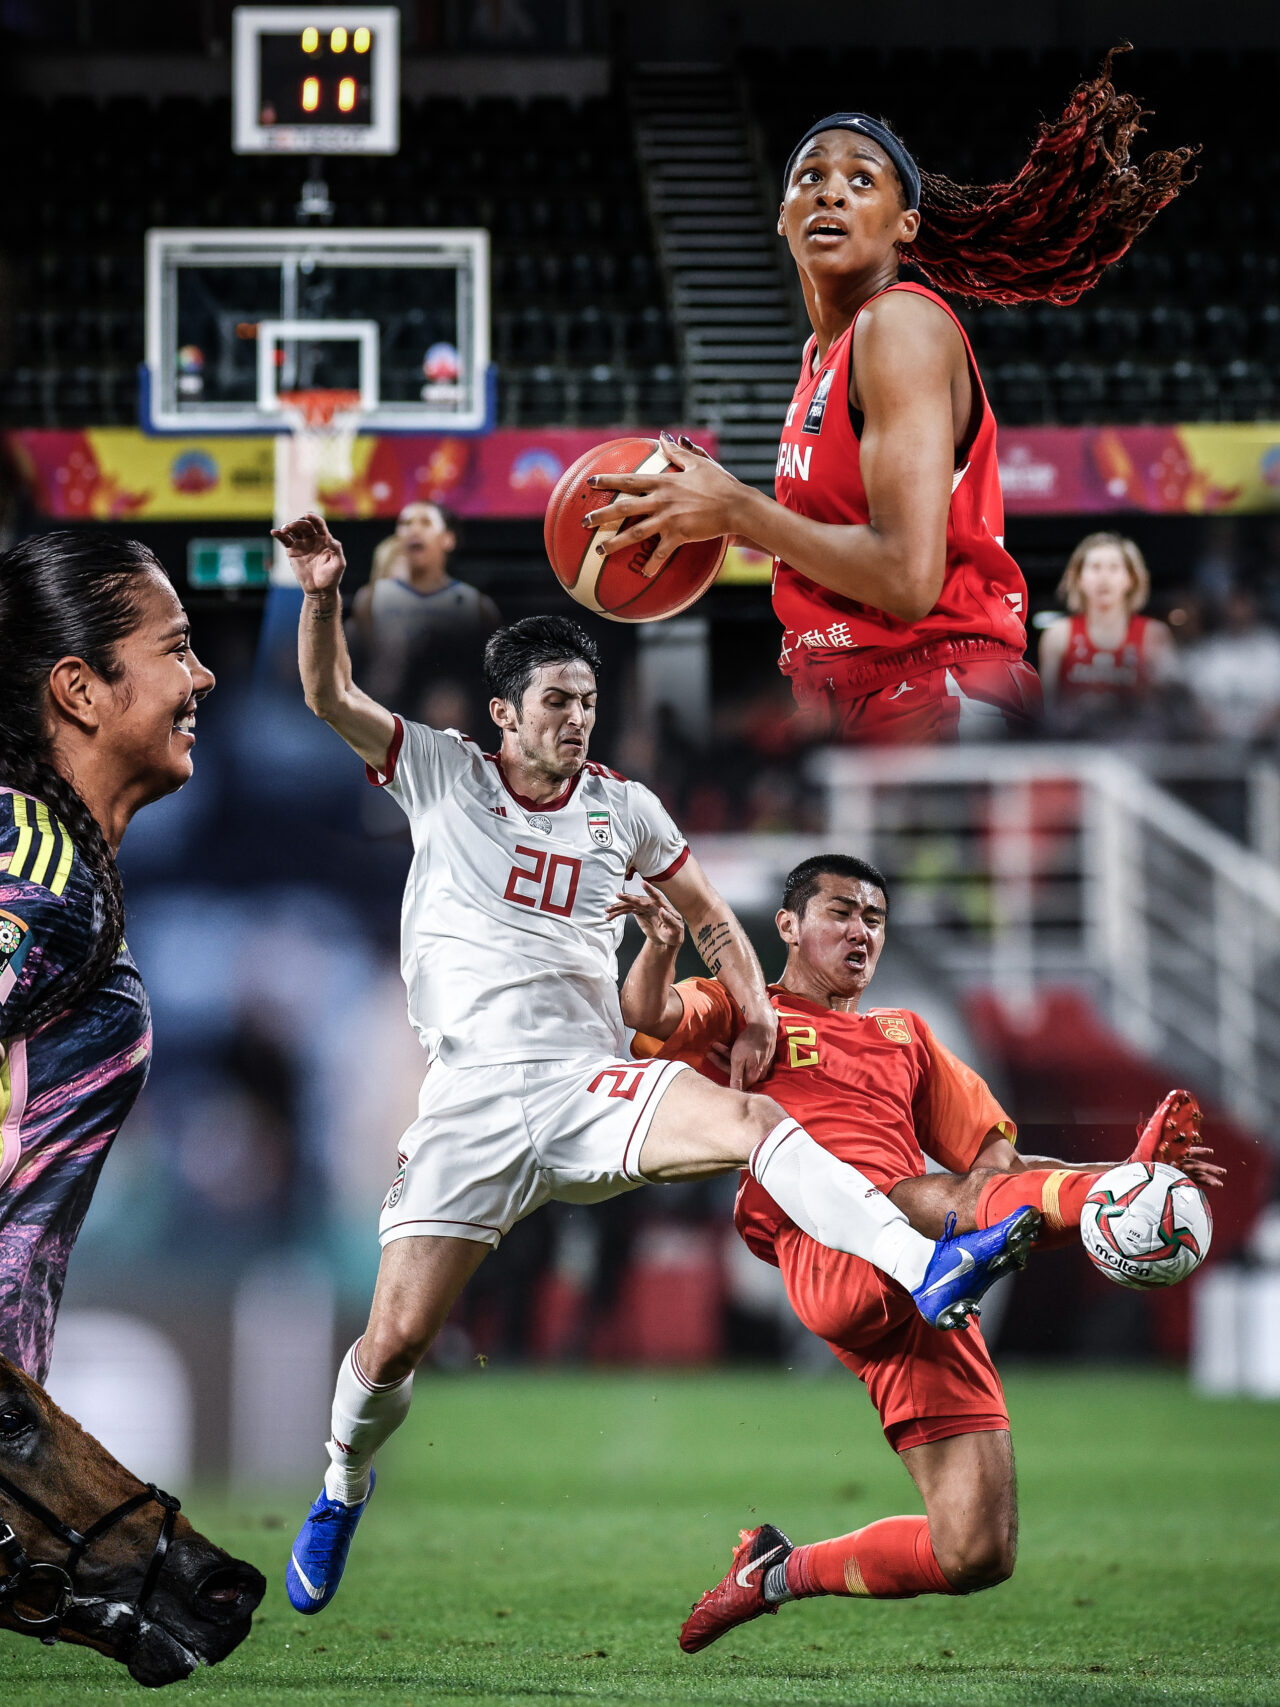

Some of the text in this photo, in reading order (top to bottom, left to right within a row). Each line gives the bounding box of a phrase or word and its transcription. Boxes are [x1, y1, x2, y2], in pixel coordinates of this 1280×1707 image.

[503, 845, 582, 918] 20
[785, 1025, 819, 1068] 2
[1095, 1244, 1150, 1277] molten
